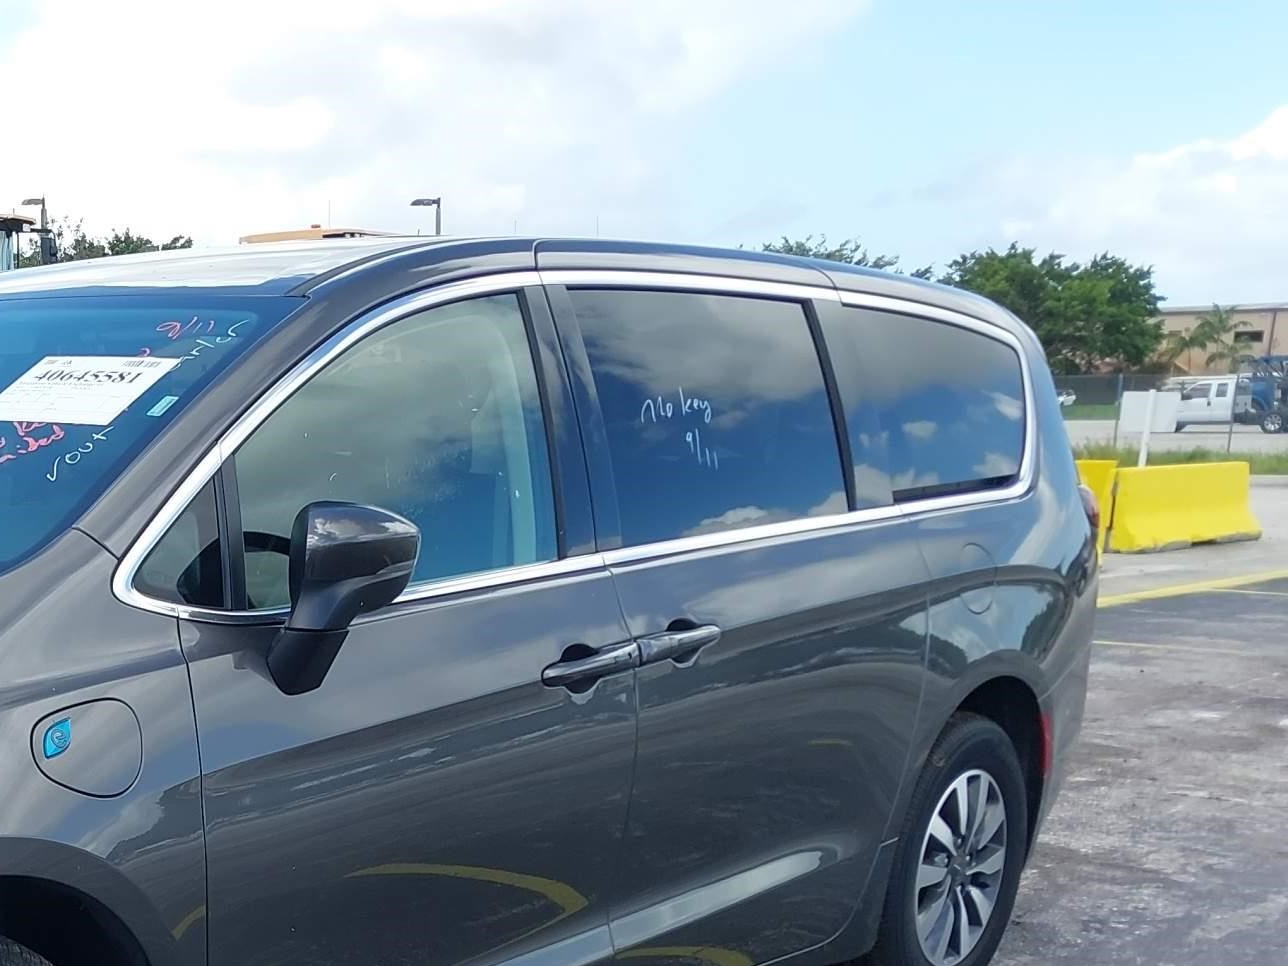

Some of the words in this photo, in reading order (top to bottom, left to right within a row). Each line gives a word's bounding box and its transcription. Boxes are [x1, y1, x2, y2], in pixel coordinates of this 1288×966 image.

[34, 370, 144, 384] 40645581
[678, 385, 713, 425] key
[685, 427, 720, 472] 9/11
